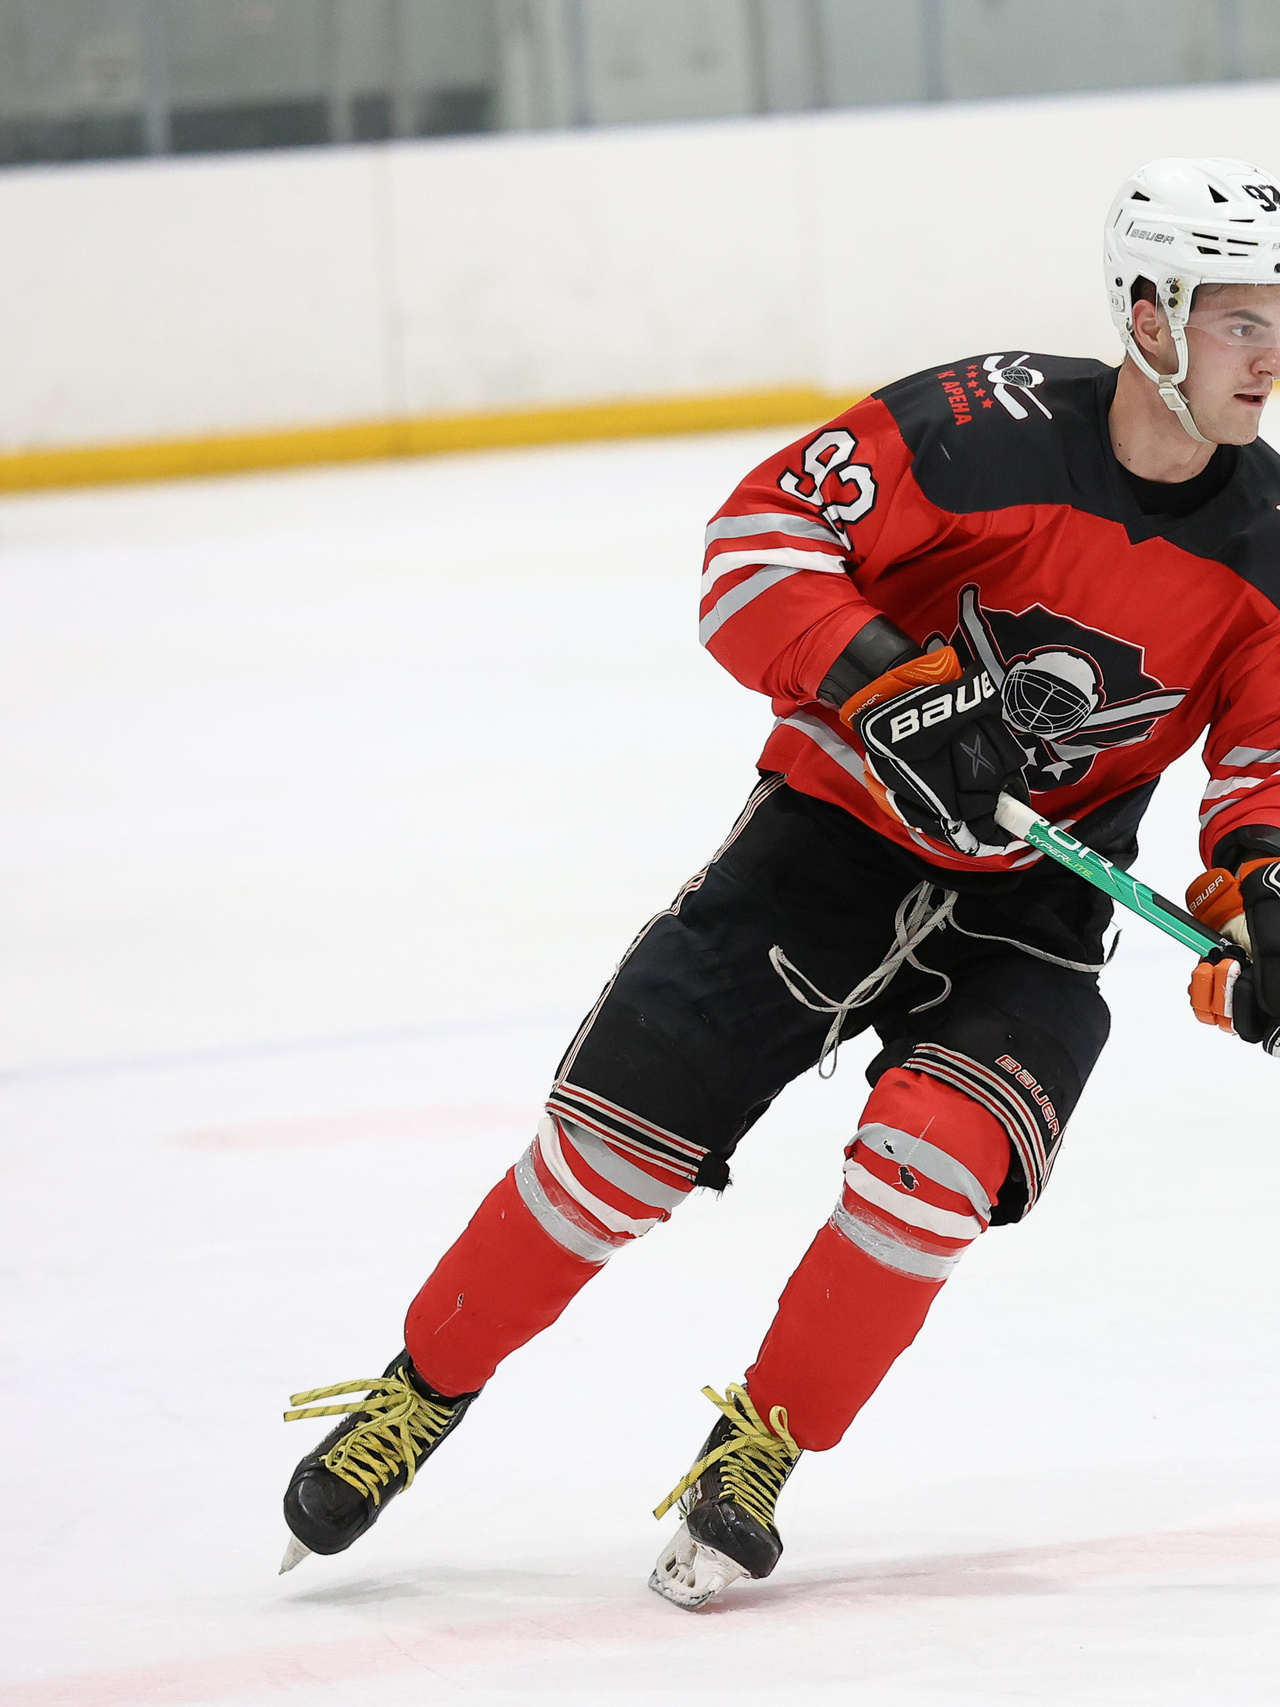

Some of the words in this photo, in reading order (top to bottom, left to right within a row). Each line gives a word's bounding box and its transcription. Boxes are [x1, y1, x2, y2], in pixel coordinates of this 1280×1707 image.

[1130, 228, 1175, 245] BAUER
[777, 426, 878, 551] 92
[1189, 875, 1225, 913] BAUER
[994, 1054, 1060, 1141] BAUER
